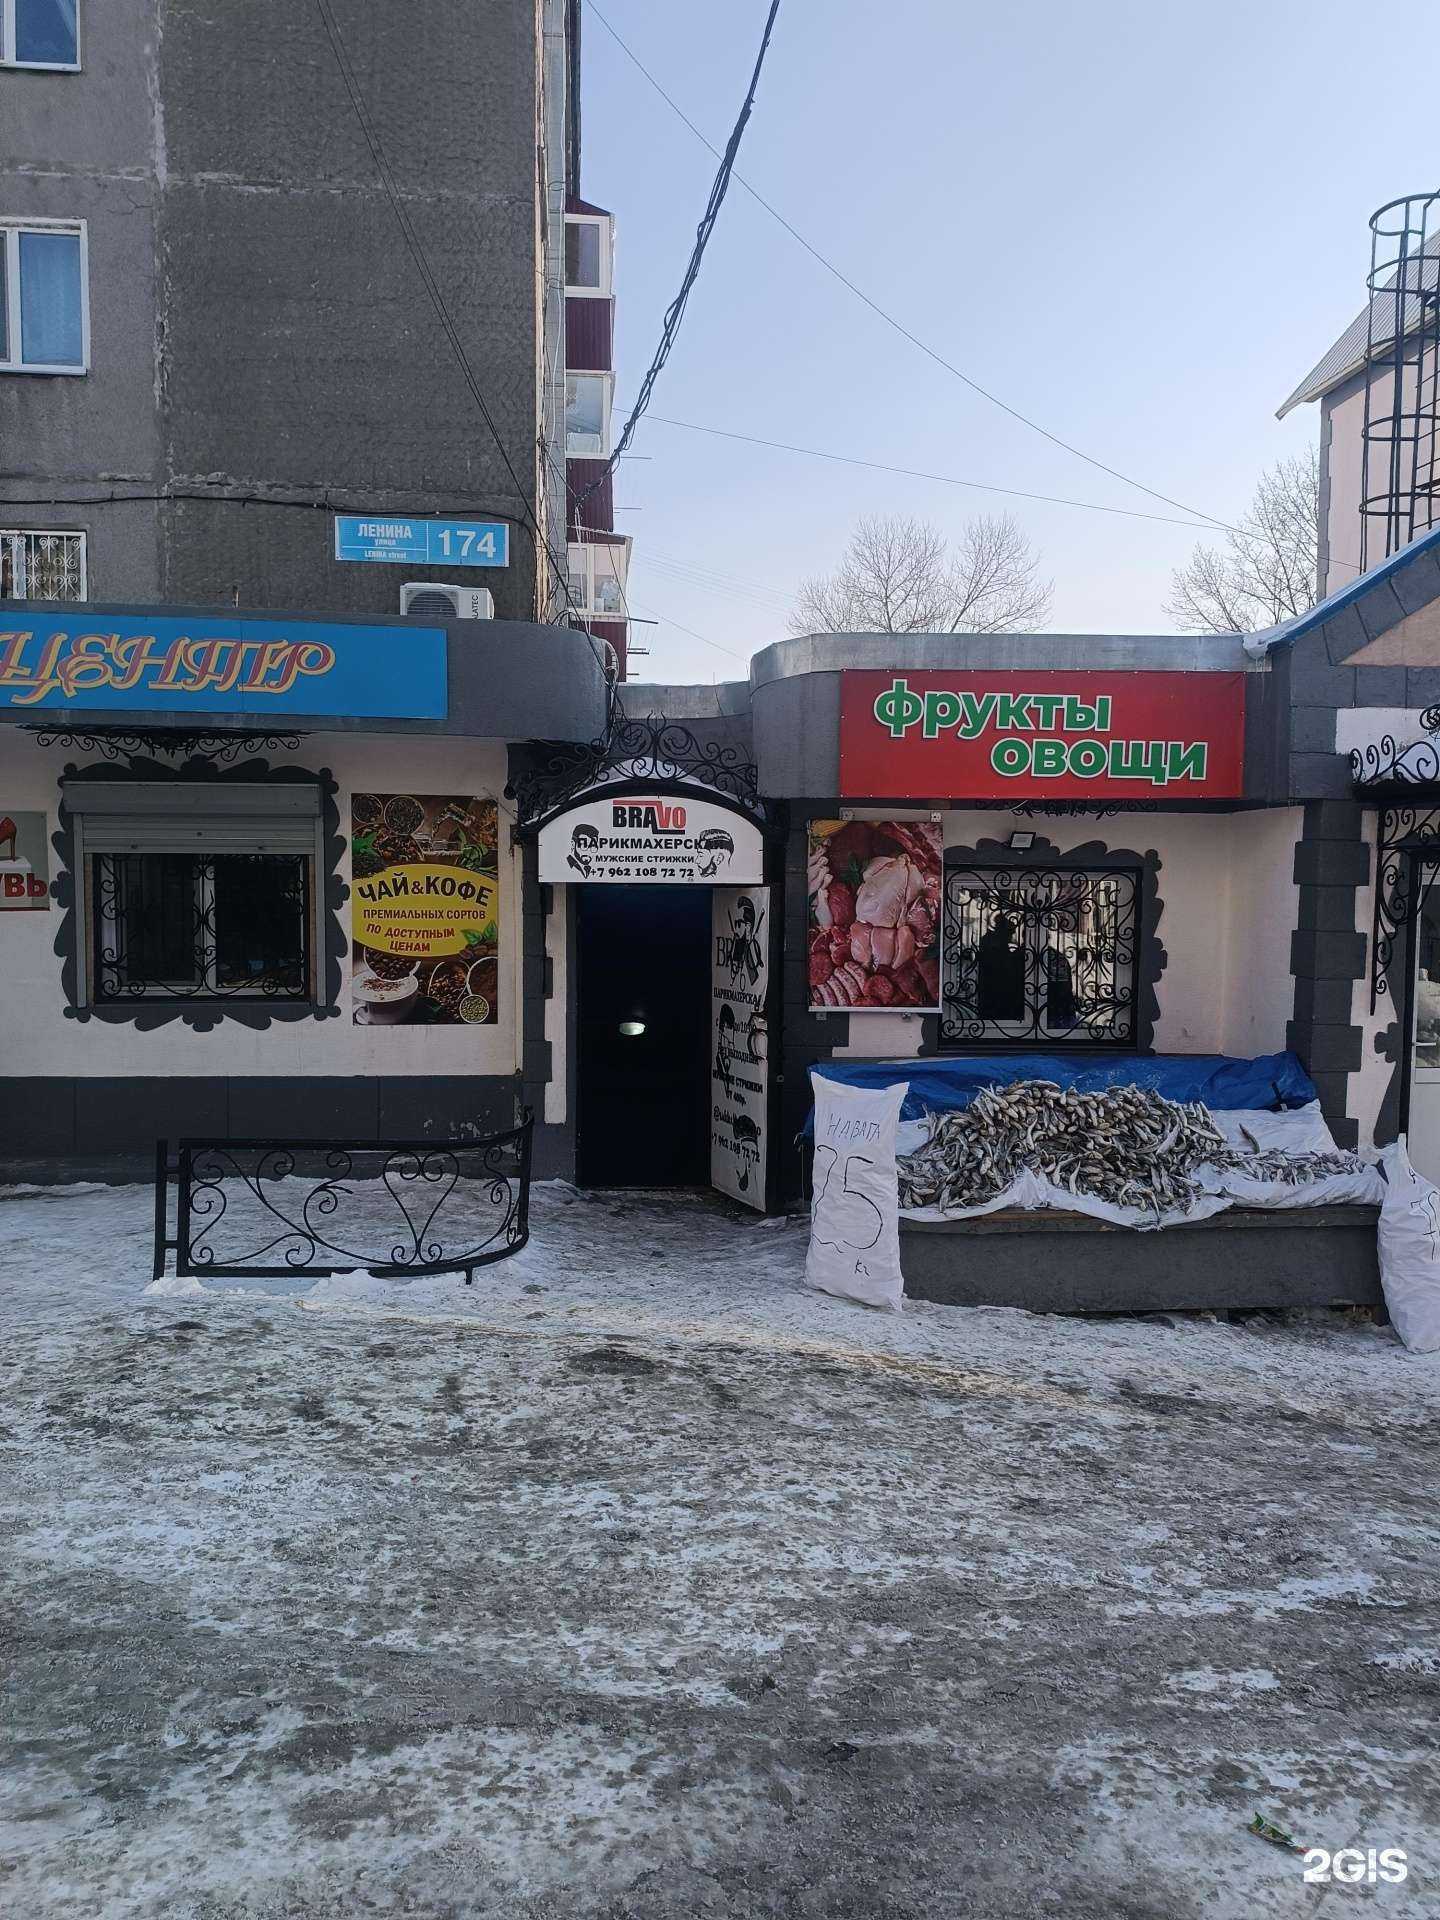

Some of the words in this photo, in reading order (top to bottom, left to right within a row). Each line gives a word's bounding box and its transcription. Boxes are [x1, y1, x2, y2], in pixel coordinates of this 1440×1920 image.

[357, 523, 412, 539] ЛЕНИНА
[374, 538, 396, 547] улица
[438, 529, 497, 559] 174
[612, 801, 687, 834] BRAVO
[577, 837, 722, 850] ПАРИКМАХЕРСК
[595, 855, 643, 863] МУЖСКИЕ
[646, 855, 694, 863] СТРИЖКИ
[591, 867, 605, 877] +7
[608, 867, 631, 877] 962
[634, 867, 657, 877] 108
[660, 868, 676, 878] 72
[679, 868, 695, 878] 72
[0, 873, 48, 897] ВЬ
[363, 909, 444, 920] ПРЕМИАЛЬНЫХ
[446, 909, 486, 920] СОРТОВ
[366, 923, 382, 934] ПО
[384, 926, 455, 939] ДОСТУПНЫМ
[389, 941, 430, 953] ЦЕНАМ
